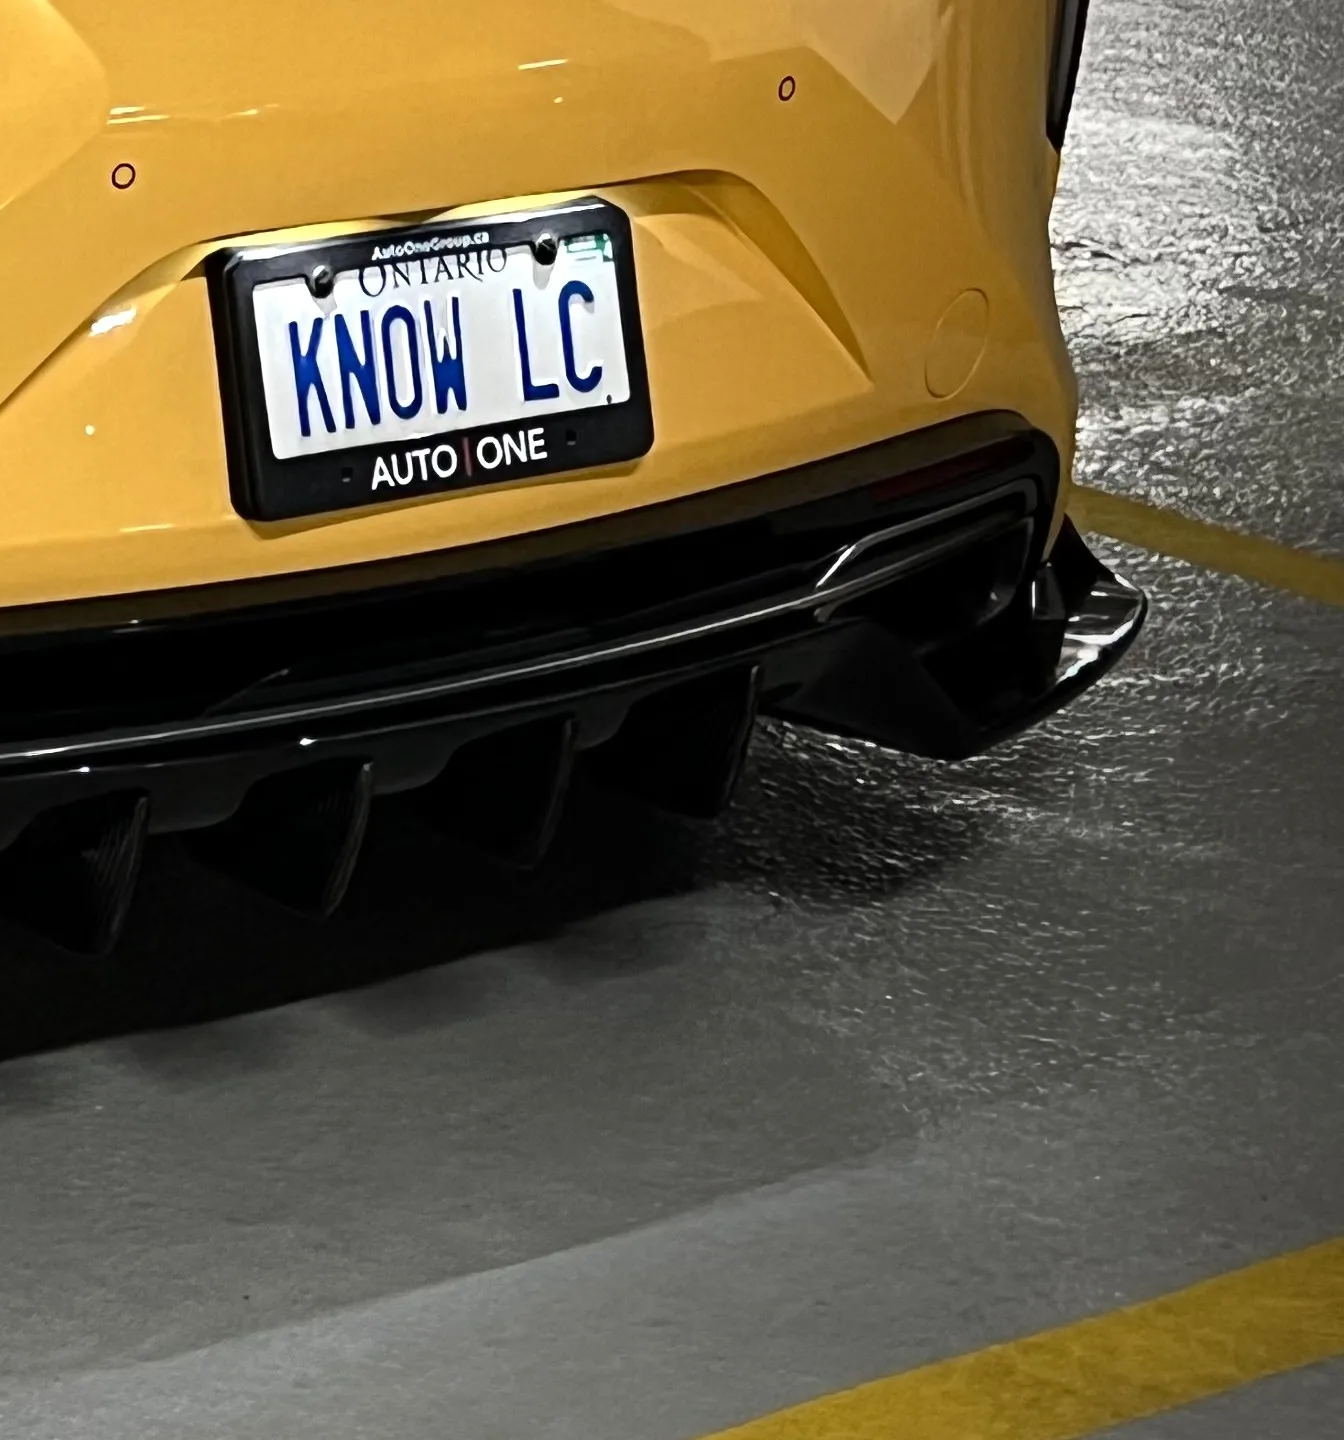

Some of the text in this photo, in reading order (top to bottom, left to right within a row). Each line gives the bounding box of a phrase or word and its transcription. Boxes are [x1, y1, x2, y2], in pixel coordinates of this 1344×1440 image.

[358, 248, 508, 298] ONTARIO
[288, 279, 604, 438] KNOW LC
[370, 427, 548, 490] AUTO ONE
